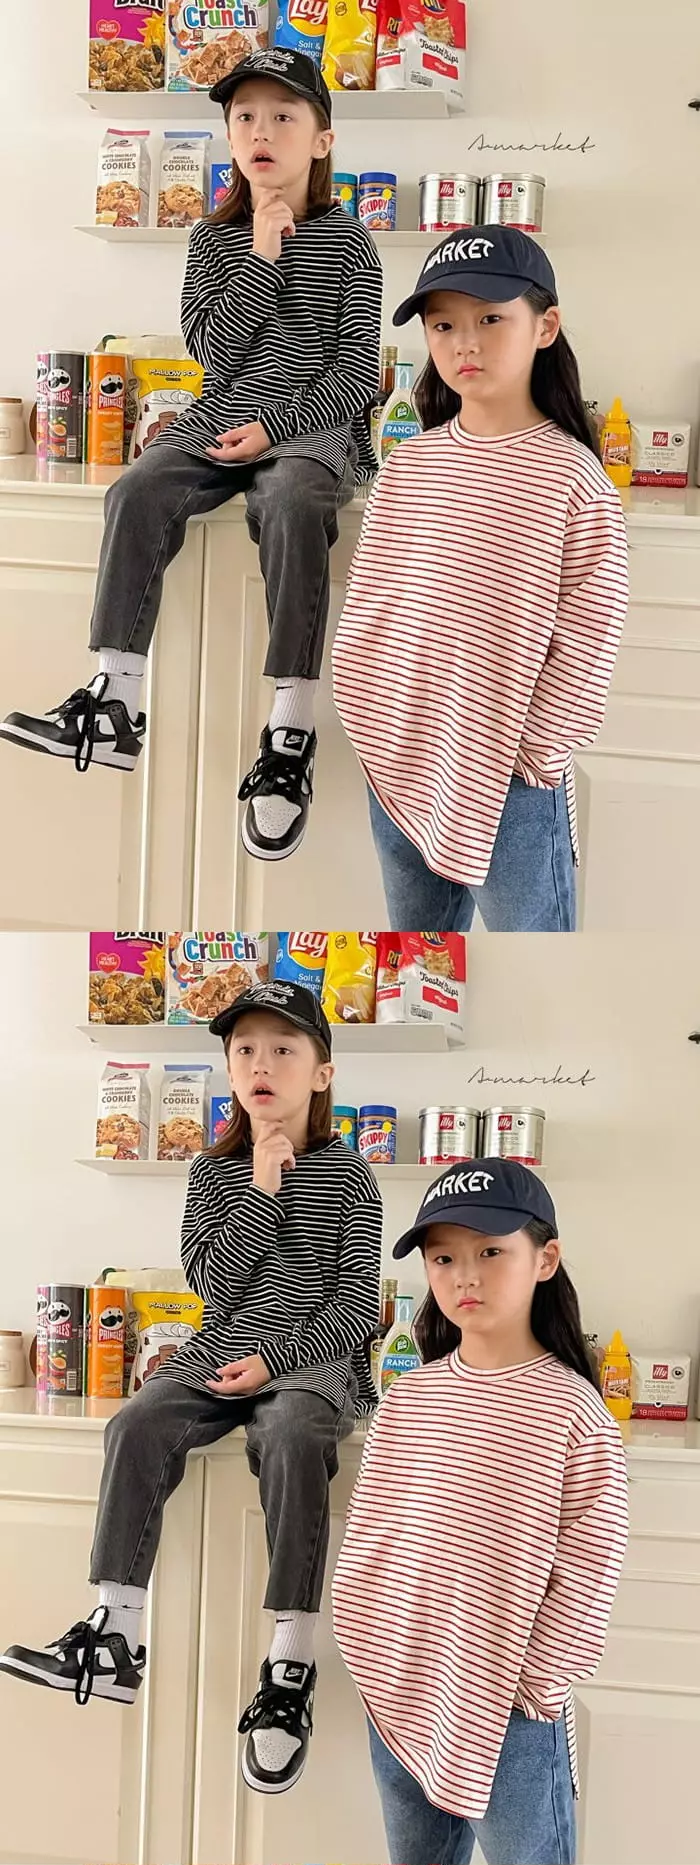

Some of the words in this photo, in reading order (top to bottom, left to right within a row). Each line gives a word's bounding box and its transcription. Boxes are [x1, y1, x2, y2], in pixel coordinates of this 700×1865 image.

[185, 3, 258, 29] Crunch
[387, 17, 401, 33] RIT
[298, 40, 314, 49] Salt
[101, 162, 137, 170] COOKIES
[162, 164, 200, 172] COOKIES
[440, 183, 454, 195] illy
[498, 184, 512, 196] illy
[359, 198, 388, 218] SKIPPY
[386, 425, 417, 434] RANCH
[653, 433, 668, 444] illy
[185, 936, 258, 962] Crunch
[387, 950, 401, 966] RIT
[298, 973, 314, 982] Salt
[101, 1095, 137, 1103] COOKIES
[162, 1097, 200, 1105] COOKIES
[440, 1116, 454, 1128] illy
[498, 1117, 512, 1129] illy
[359, 1131, 388, 1151] SKIPPY
[386, 1358, 417, 1367] RANCH
[653, 1366, 668, 1377] illy
